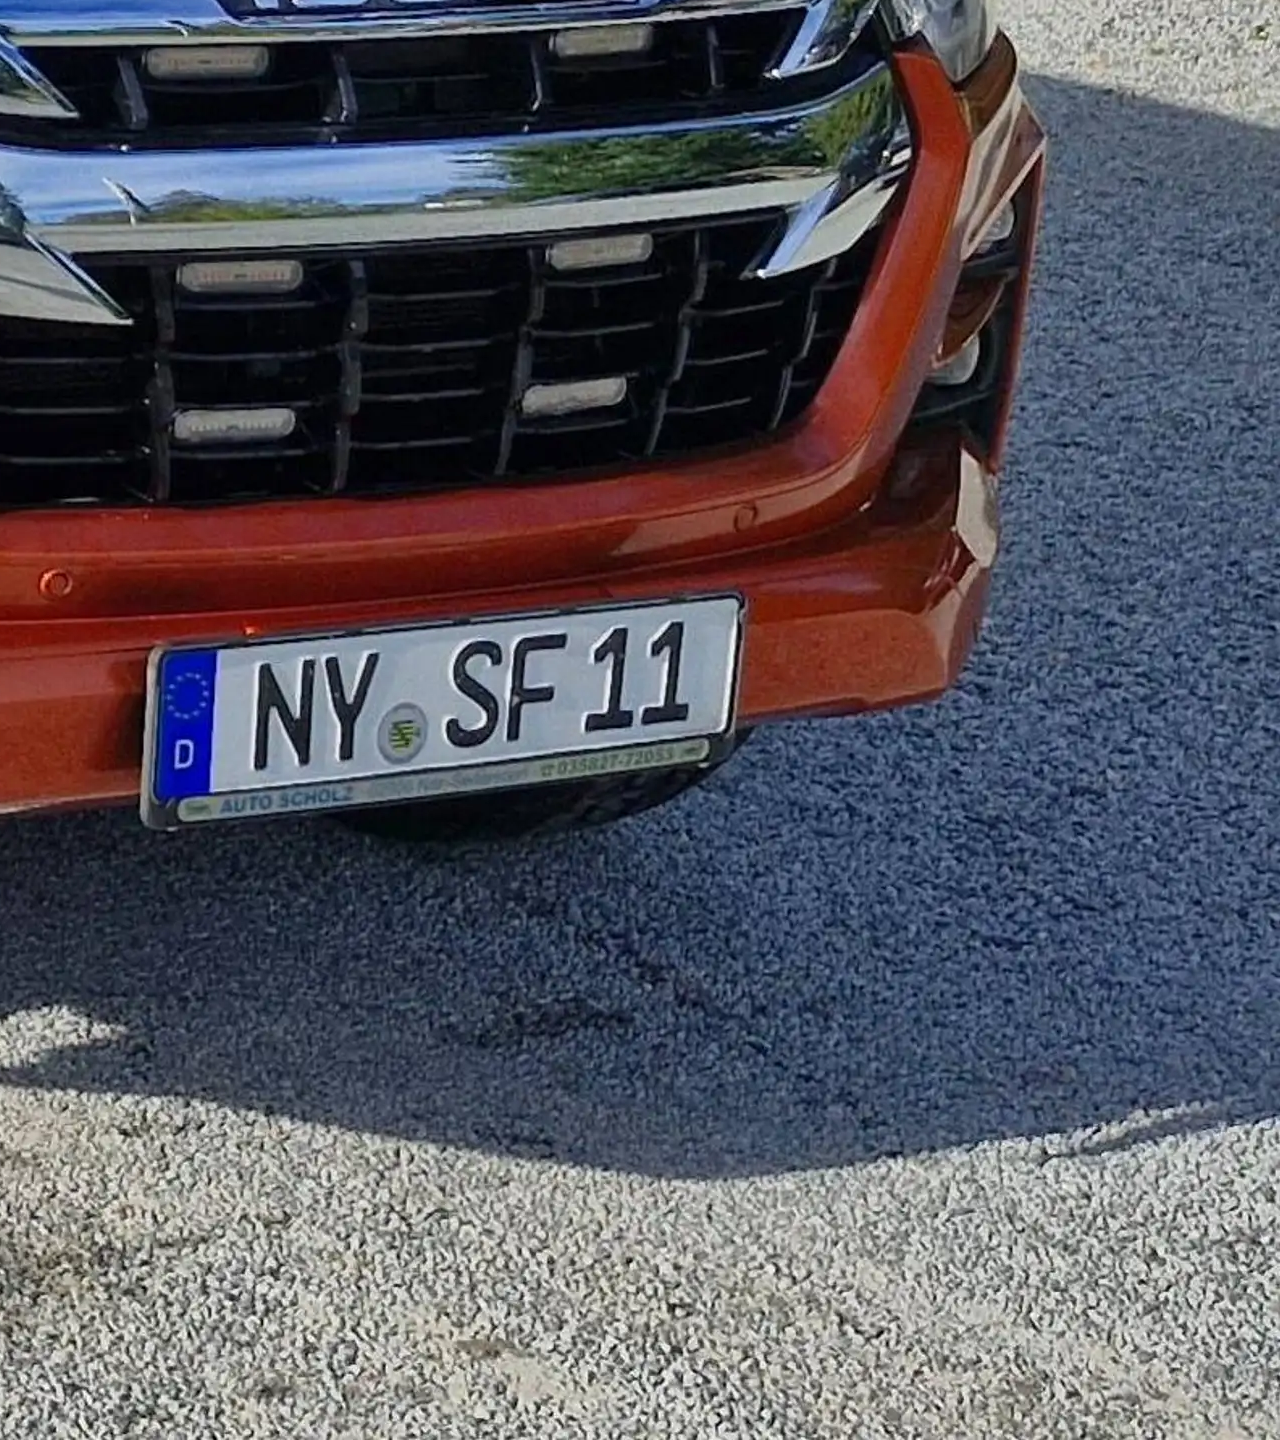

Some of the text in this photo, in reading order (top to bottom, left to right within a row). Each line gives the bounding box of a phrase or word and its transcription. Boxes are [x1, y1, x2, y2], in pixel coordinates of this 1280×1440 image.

[252, 620, 690, 770] NY SF 11
[173, 739, 194, 769] D
[218, 793, 272, 815] AUTO
[279, 786, 354, 809] SCHOLZ
